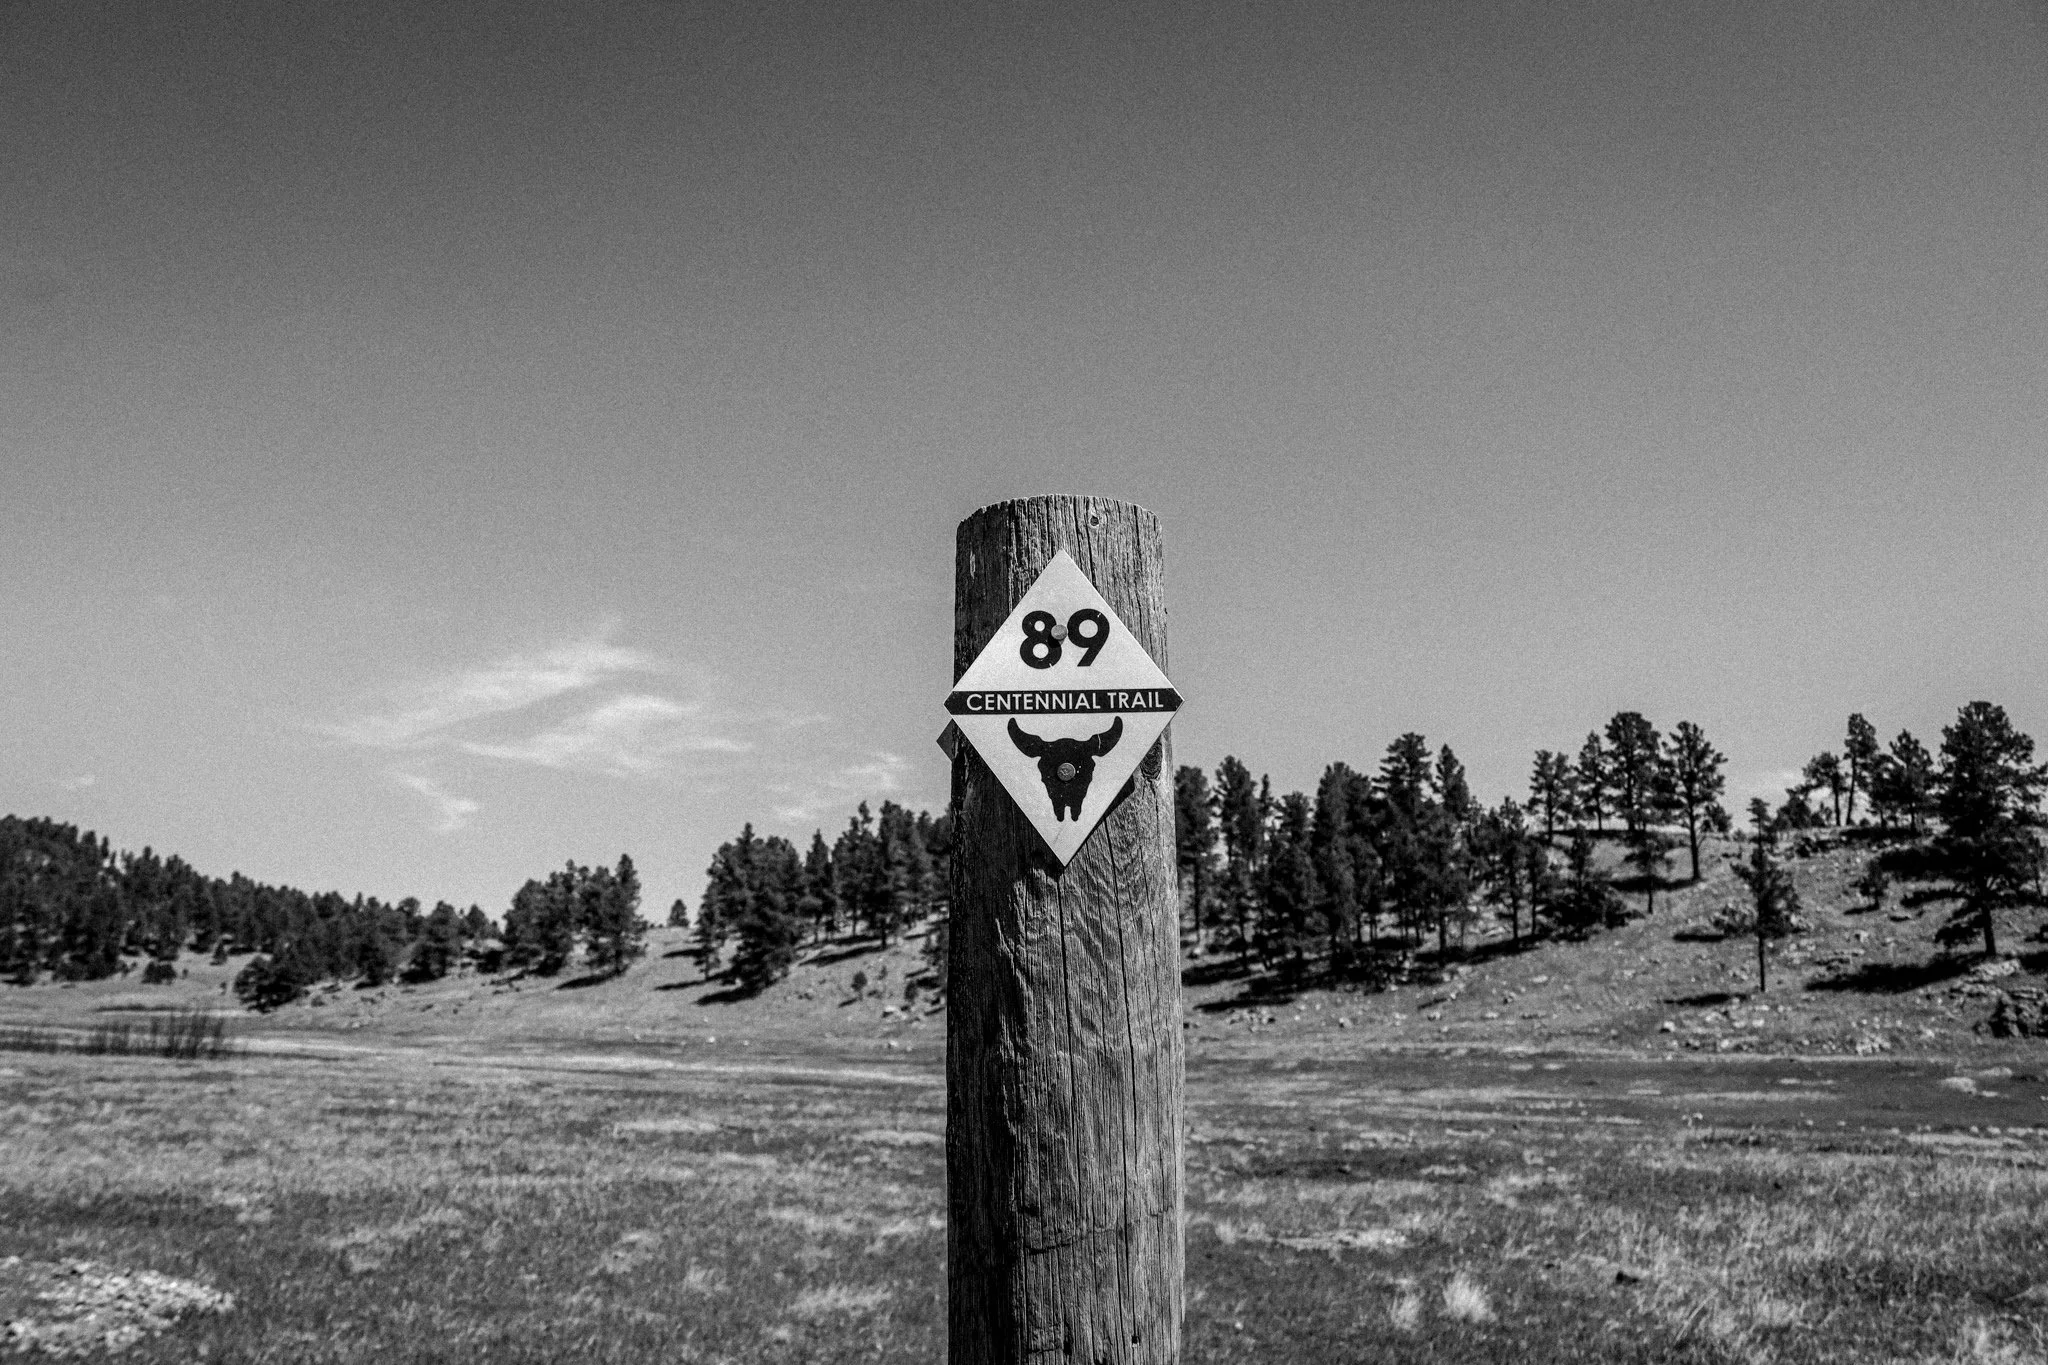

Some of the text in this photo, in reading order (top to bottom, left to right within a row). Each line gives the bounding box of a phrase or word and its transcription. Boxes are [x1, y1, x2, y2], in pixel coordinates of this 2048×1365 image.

[1019, 608, 1110, 670] 89
[966, 691, 1164, 711] CENTENNIAL TRAIL
